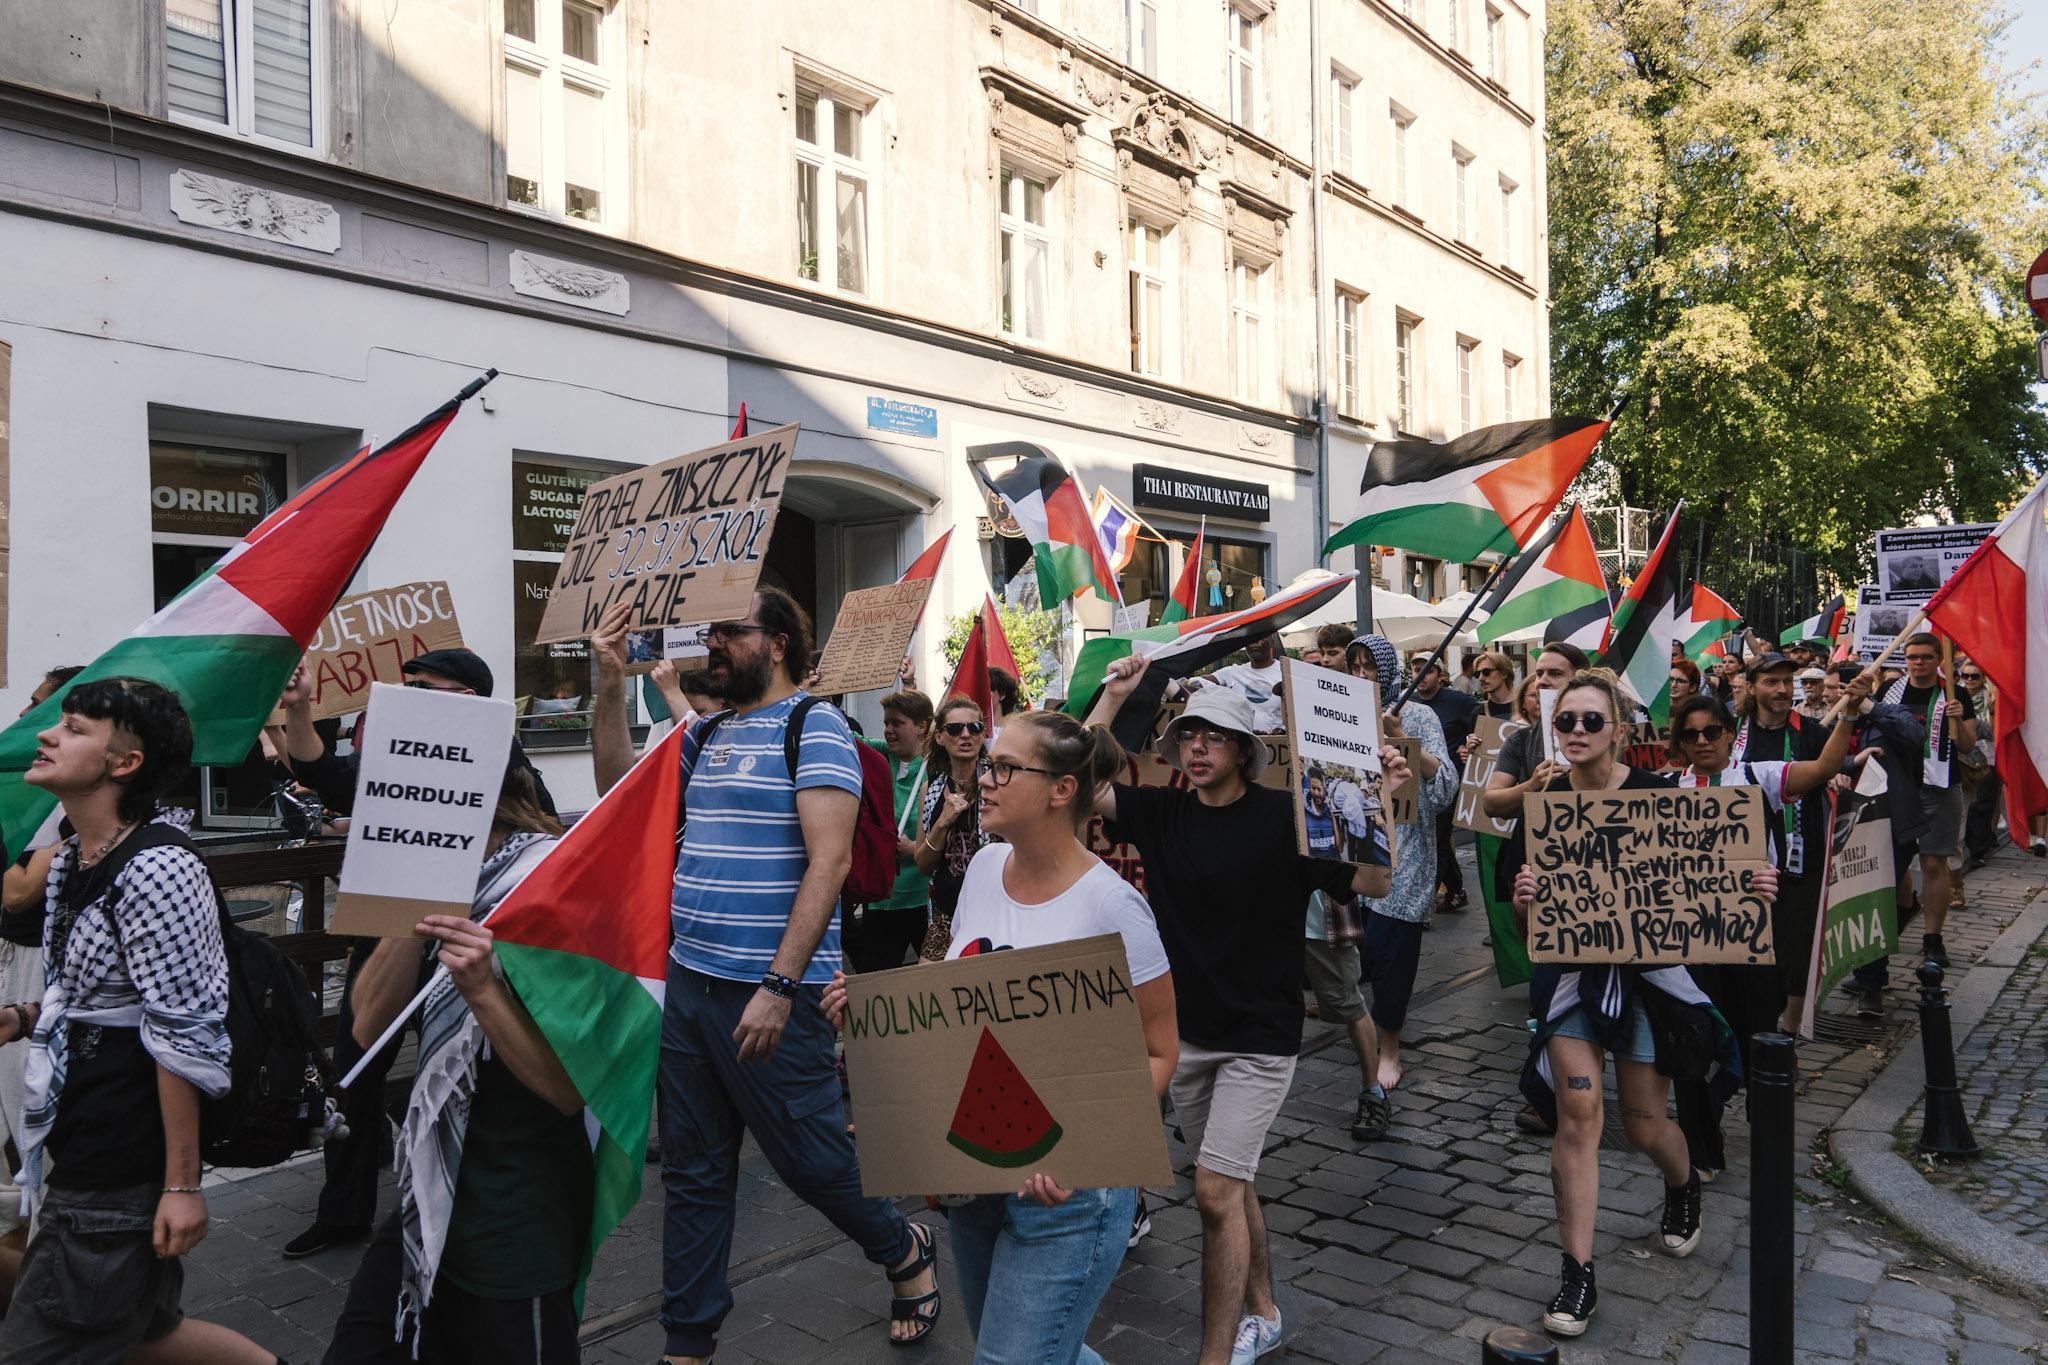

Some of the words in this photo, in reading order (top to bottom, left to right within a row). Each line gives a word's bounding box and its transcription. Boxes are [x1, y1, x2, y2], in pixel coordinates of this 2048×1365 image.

[526, 472, 577, 489] GLUTEN
[573, 478, 644, 541] IZRAEL
[645, 442, 786, 522] ZNISZCZYŁ
[1143, 476, 1172, 496] THAI
[1174, 482, 1242, 507] RESTAURANT
[1243, 493, 1268, 510] ZAAB
[151, 485, 259, 515] ORRIR
[529, 489, 574, 504] SUGAR
[561, 531, 609, 589] JUŻ
[607, 514, 688, 580] 92.9%
[678, 496, 769, 571] SZKÓŁ
[1906, 542, 1933, 551] pomoc
[582, 583, 615, 633] W
[550, 650, 570, 658] Coffee
[577, 650, 588, 658] Tea
[553, 642, 584, 650] Smoothie
[1317, 678, 1350, 697] IZRAEL
[1313, 705, 1359, 726] MORDUJE
[1930, 700, 1945, 753] PALESTINE
[389, 738, 474, 763] IZRAEL
[1304, 731, 1372, 756] DZIENNIKARZY
[365, 781, 485, 808] MORDUJE
[362, 825, 475, 850] LEKARZY
[848, 991, 949, 1040] WOLNA
[951, 965, 1134, 1026] PALESTYNA
